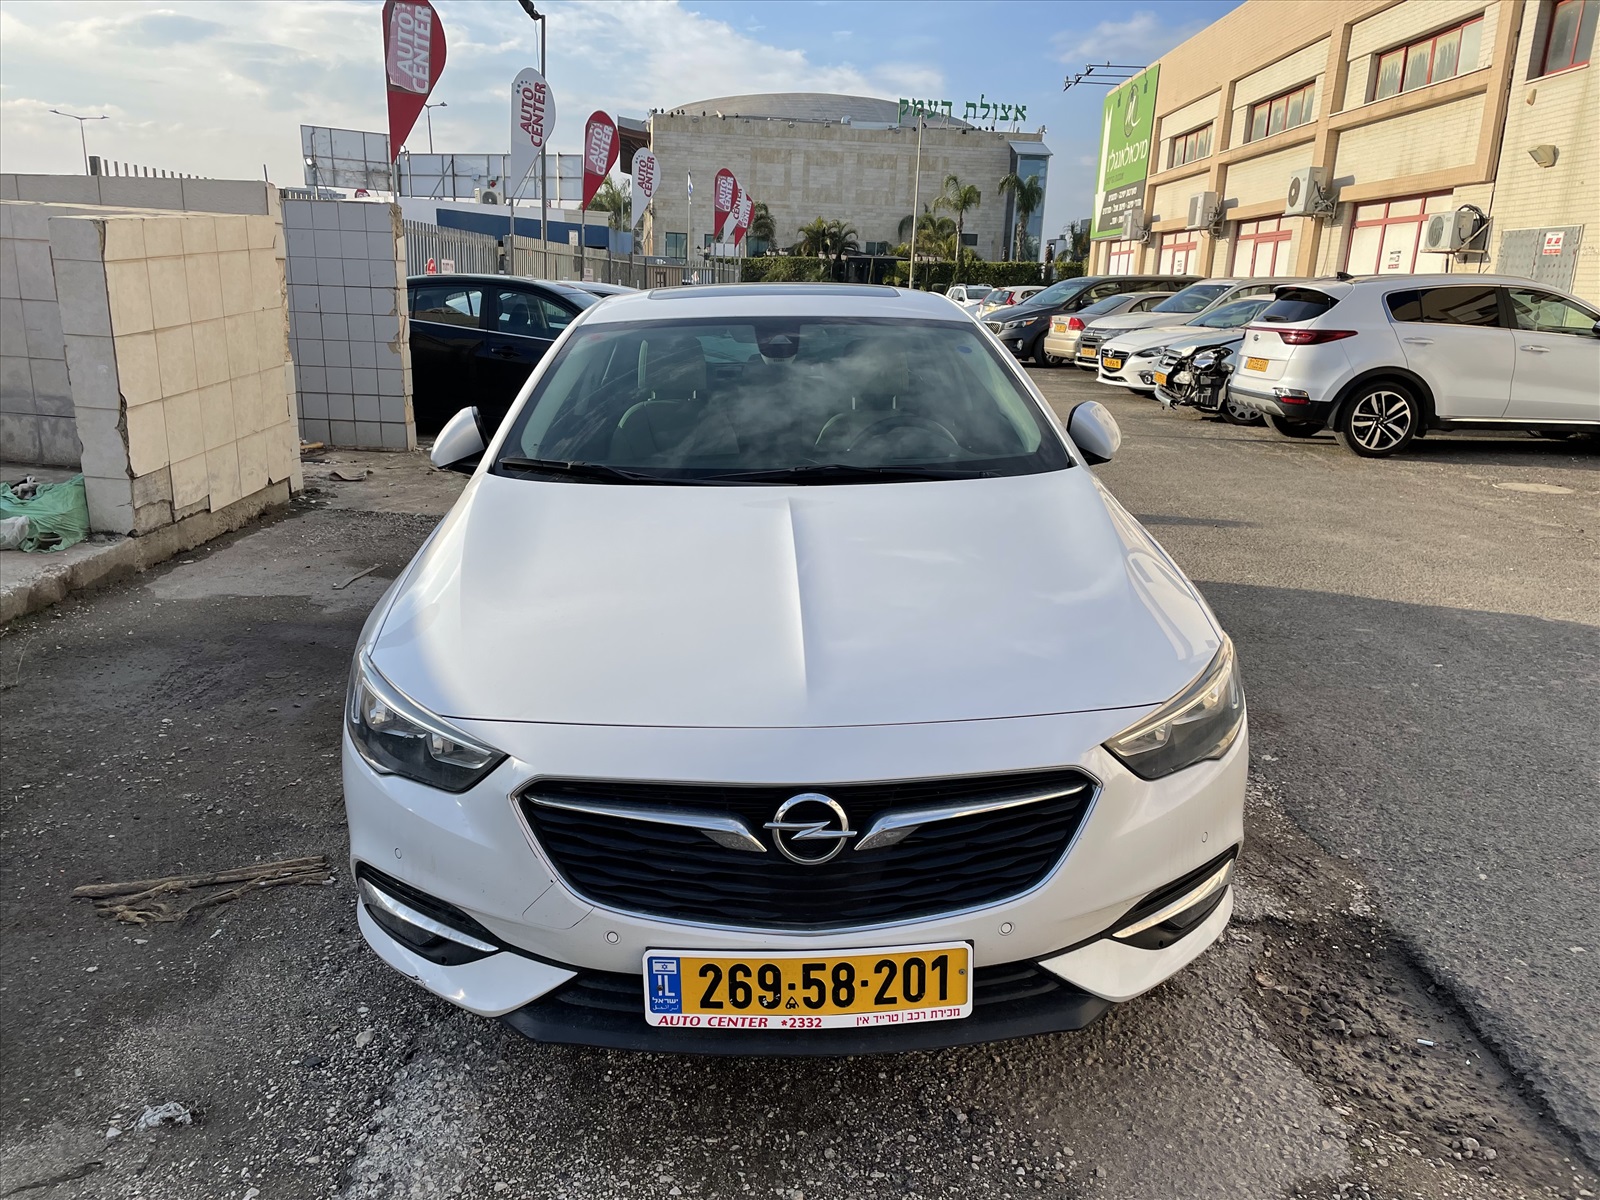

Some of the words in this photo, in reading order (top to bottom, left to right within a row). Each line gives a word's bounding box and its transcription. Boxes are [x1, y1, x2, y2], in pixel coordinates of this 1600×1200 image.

[396, 12, 414, 76] AUTO
[412, 5, 431, 94] CENTER
[520, 87, 534, 135] AUTO
[531, 82, 546, 147] CENTER
[898, 97, 953, 123] העמק
[963, 94, 1027, 122] אצולת
[588, 128, 603, 166] AUTO
[596, 125, 614, 176] CENTER
[637, 159, 647, 190] AUTO
[644, 156, 655, 198] CENTER
[719, 180, 727, 205] AUTO
[724, 176, 734, 212] CENTER
[657, 974, 676, 997] IL
[651, 996, 679, 1004] ישראל
[930, 1007, 961, 1019] מכירת
[657, 1015, 701, 1027] AUTO
[707, 1016, 769, 1028] CENTER
[856, 1016, 870, 1026] אין
[872, 1013, 899, 1023] טרייד
[906, 1011, 926, 1021] רכב
